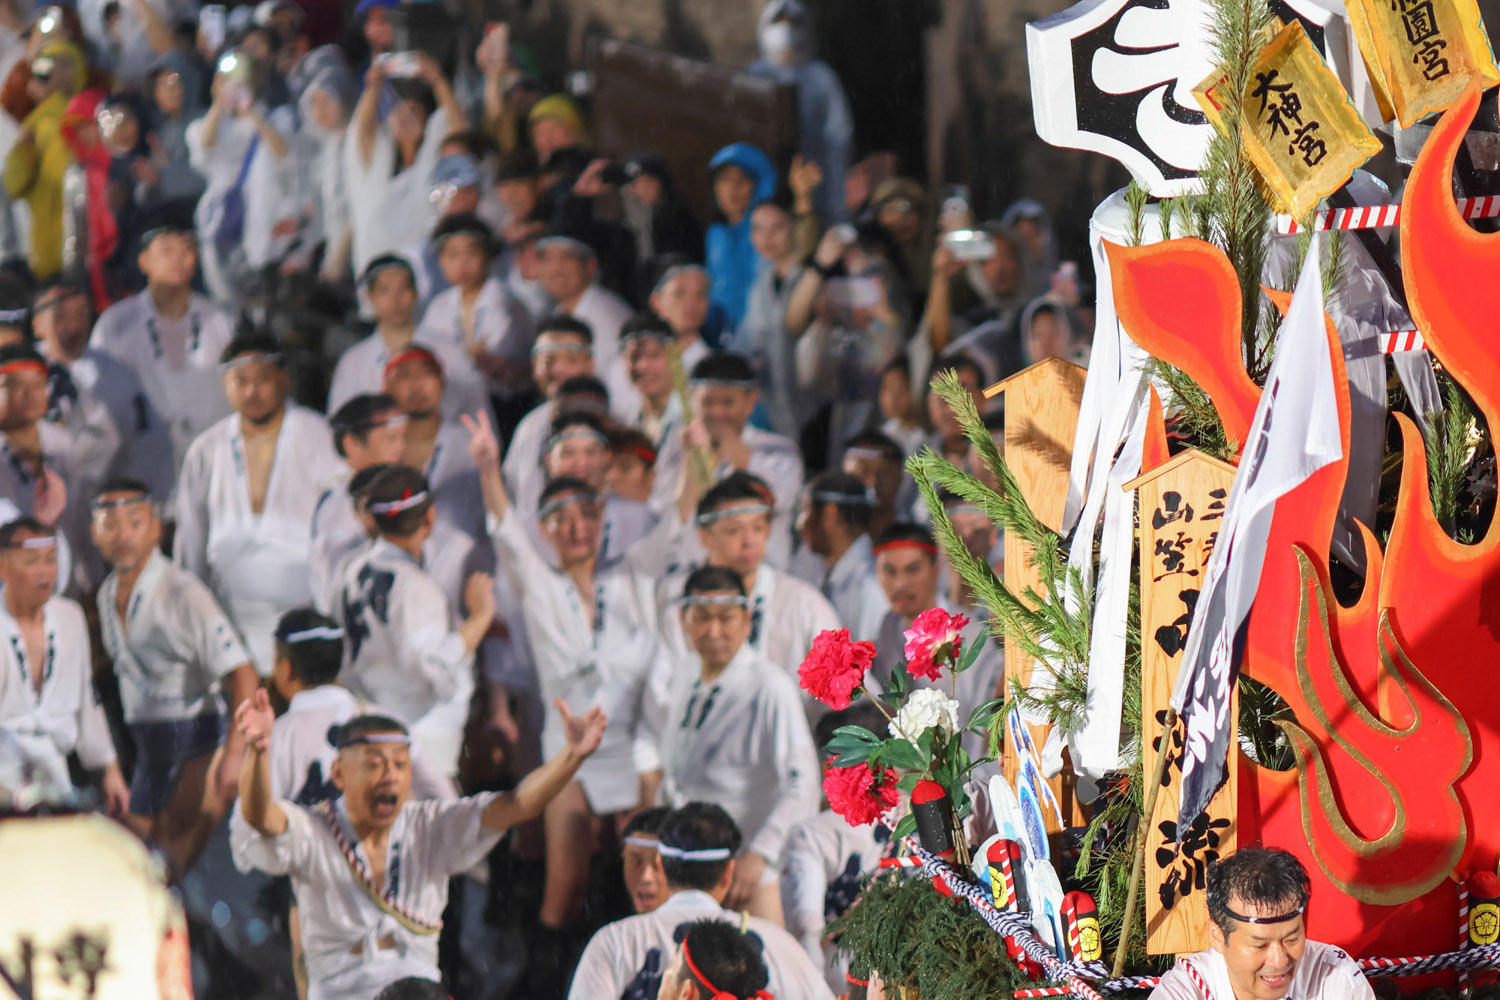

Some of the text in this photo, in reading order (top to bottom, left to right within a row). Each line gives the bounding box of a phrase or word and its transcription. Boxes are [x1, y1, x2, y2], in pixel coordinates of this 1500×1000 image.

[1392, 0, 1450, 81] 園宮
[1251, 69, 1328, 168] 大神宮
